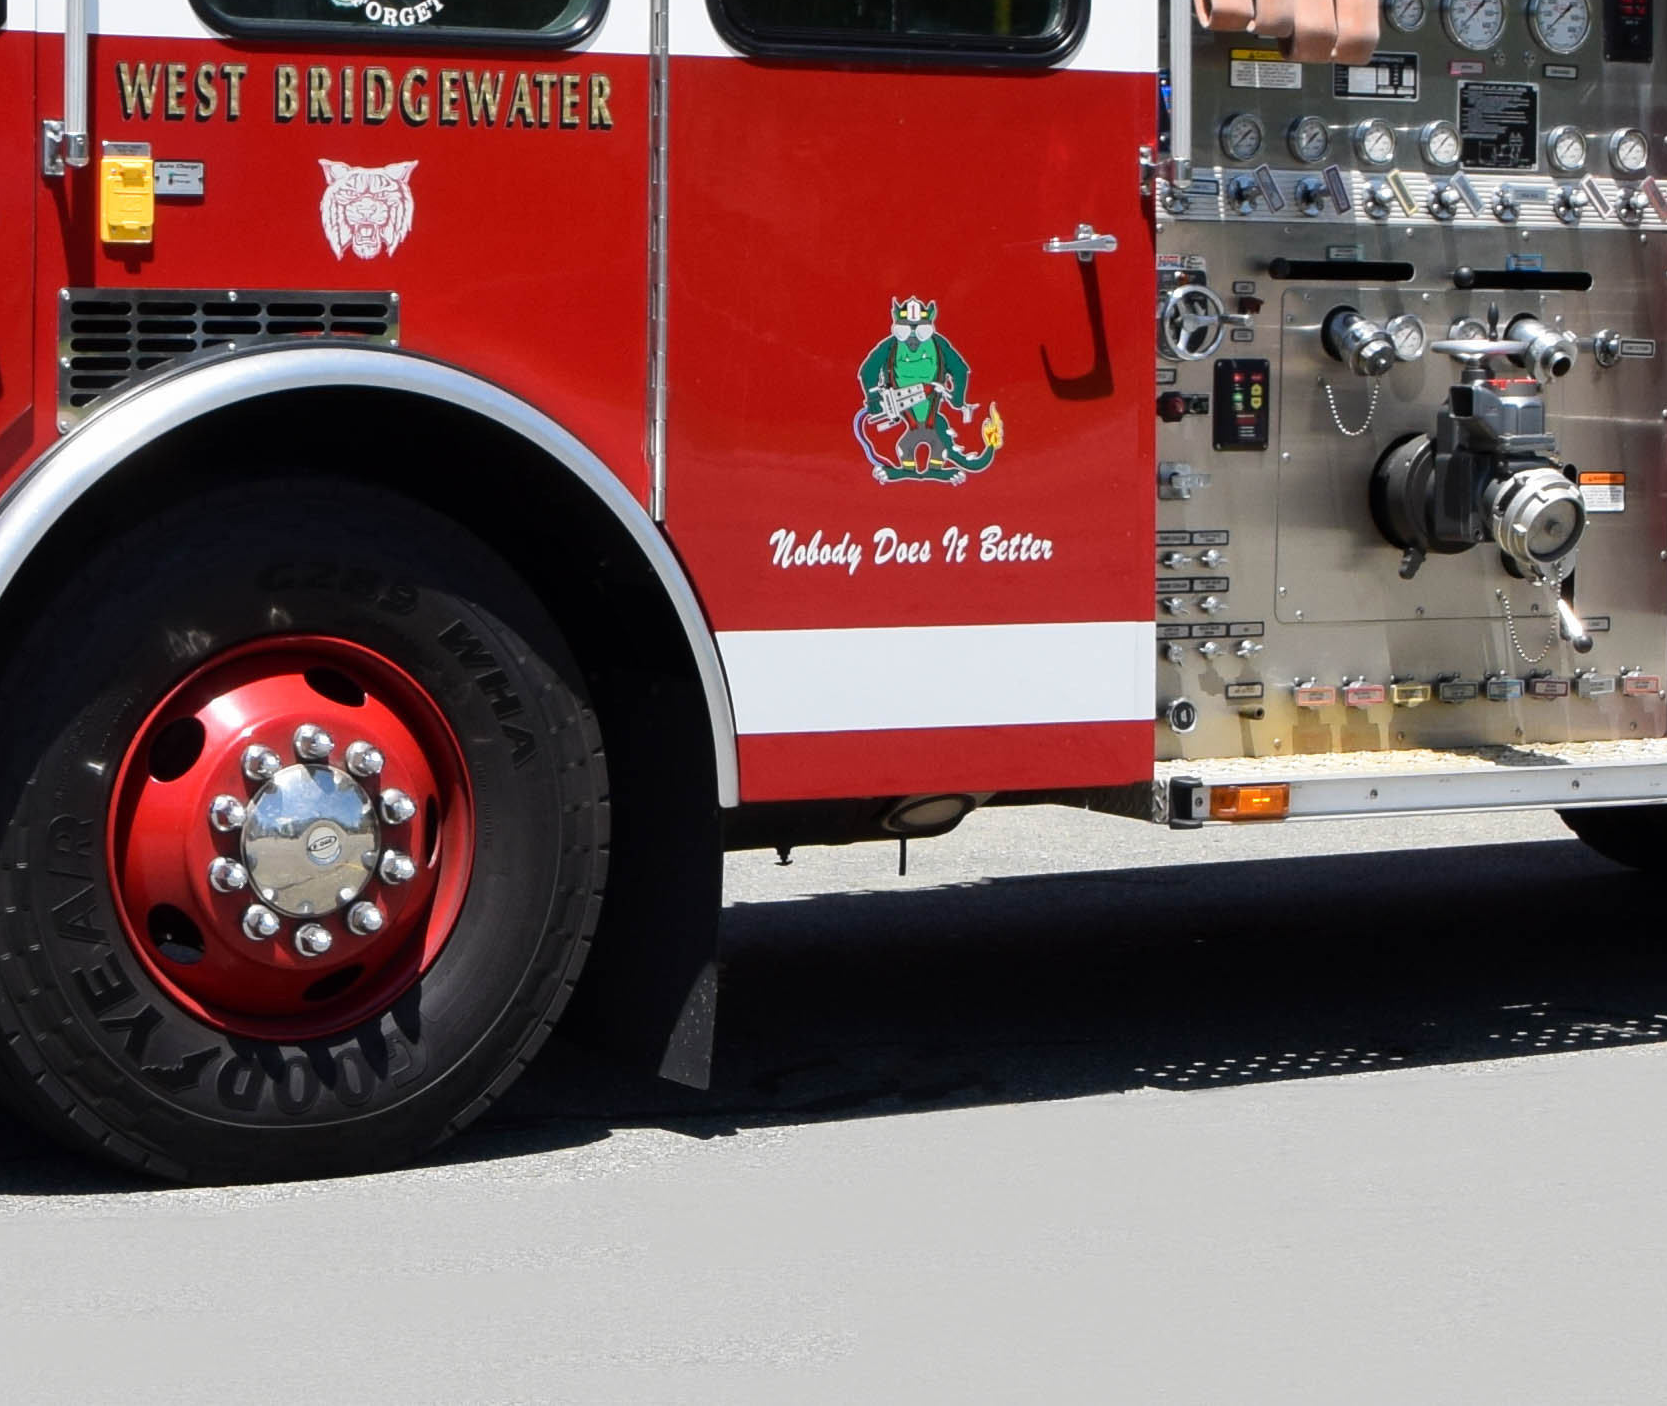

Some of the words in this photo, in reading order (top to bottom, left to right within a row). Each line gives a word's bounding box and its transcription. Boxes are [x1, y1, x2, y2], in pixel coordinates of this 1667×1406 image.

[116, 61, 247, 121] WEST
[274, 64, 615, 131] BRIDGEWATER
[910, 304, 918, 320] 1
[769, 528, 862, 575] Nobody
[873, 527, 931, 564] Does
[942, 525, 967, 563] It
[979, 525, 1053, 561] Better
[438, 619, 538, 771] WHA
[45, 813, 430, 1116] GOODYEAR
